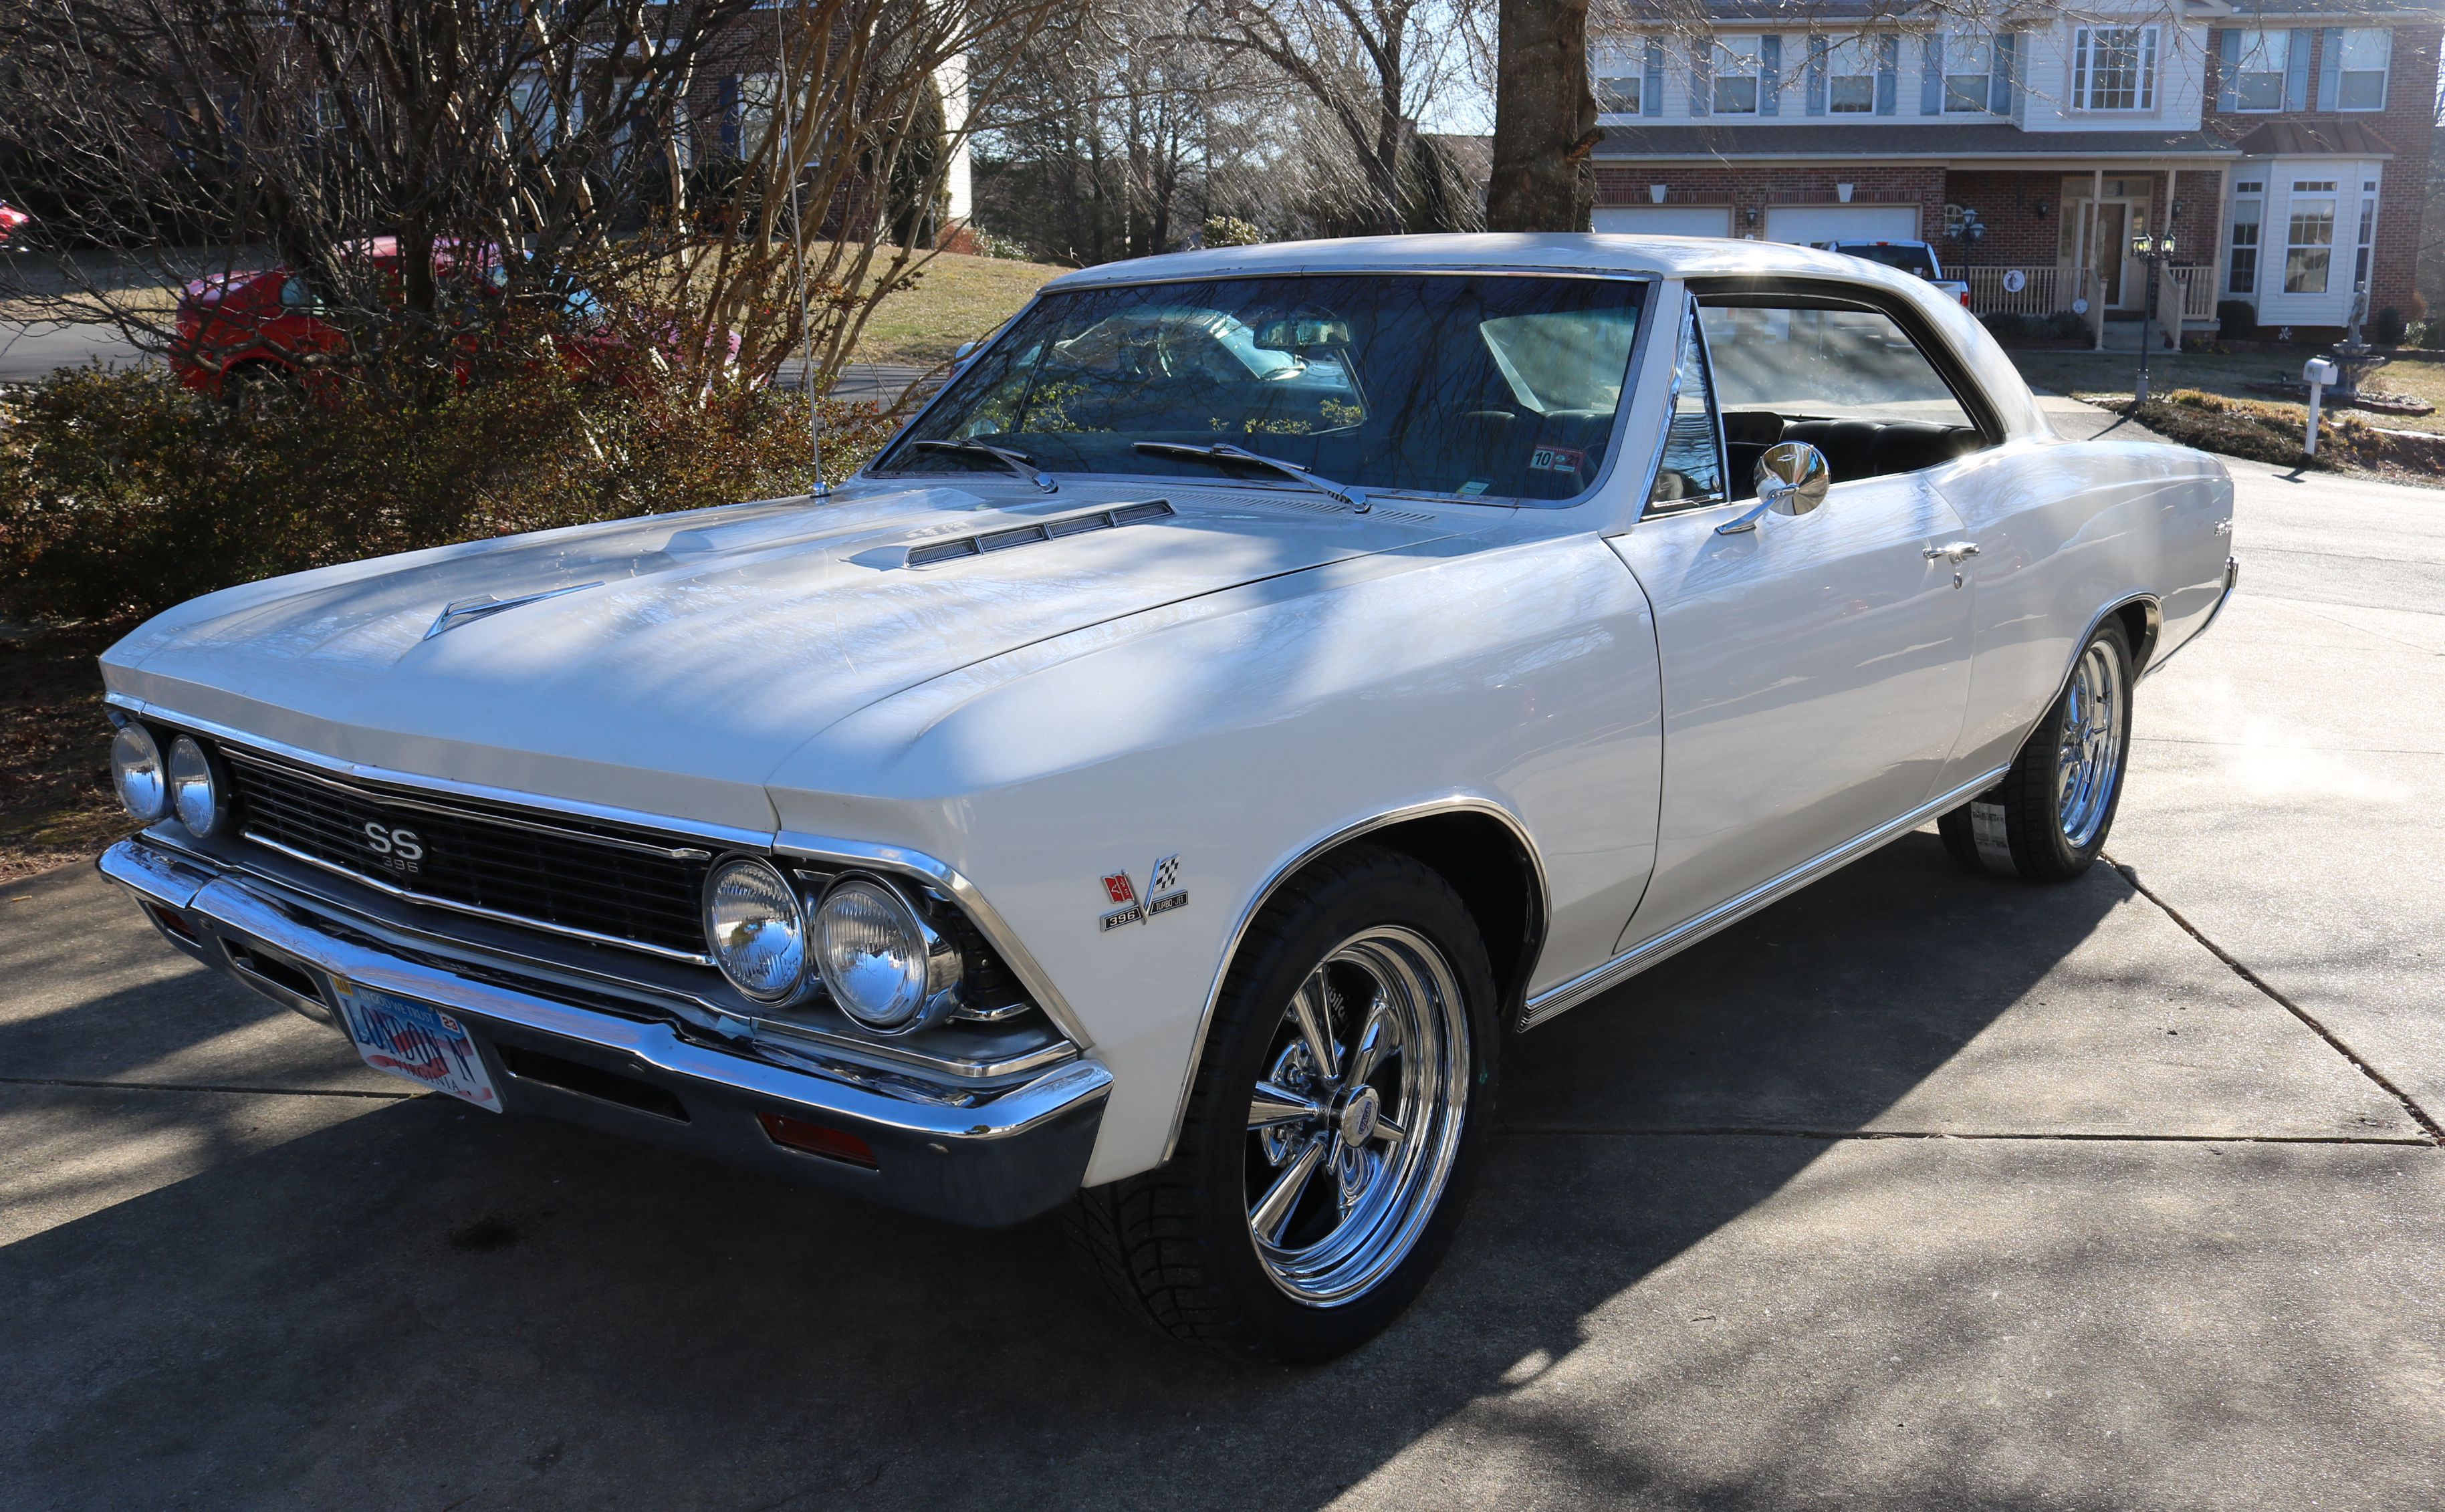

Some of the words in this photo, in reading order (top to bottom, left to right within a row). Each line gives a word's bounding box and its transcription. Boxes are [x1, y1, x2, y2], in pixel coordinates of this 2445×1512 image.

[1536, 451, 1551, 466] 10
[1566, 455, 1581, 466] 21
[365, 822, 423, 860] SS
[382, 856, 419, 873] 396
[1109, 910, 1135, 926] 396
[358, 989, 371, 1002] IN
[370, 993, 391, 1009] GOD
[391, 1001, 407, 1015] WE
[405, 1006, 435, 1024] TRUST
[442, 1016, 459, 1031] 23
[393, 1058, 461, 1092] VIRGINIA
[1359, 1102, 1372, 1135] CRAGAR
